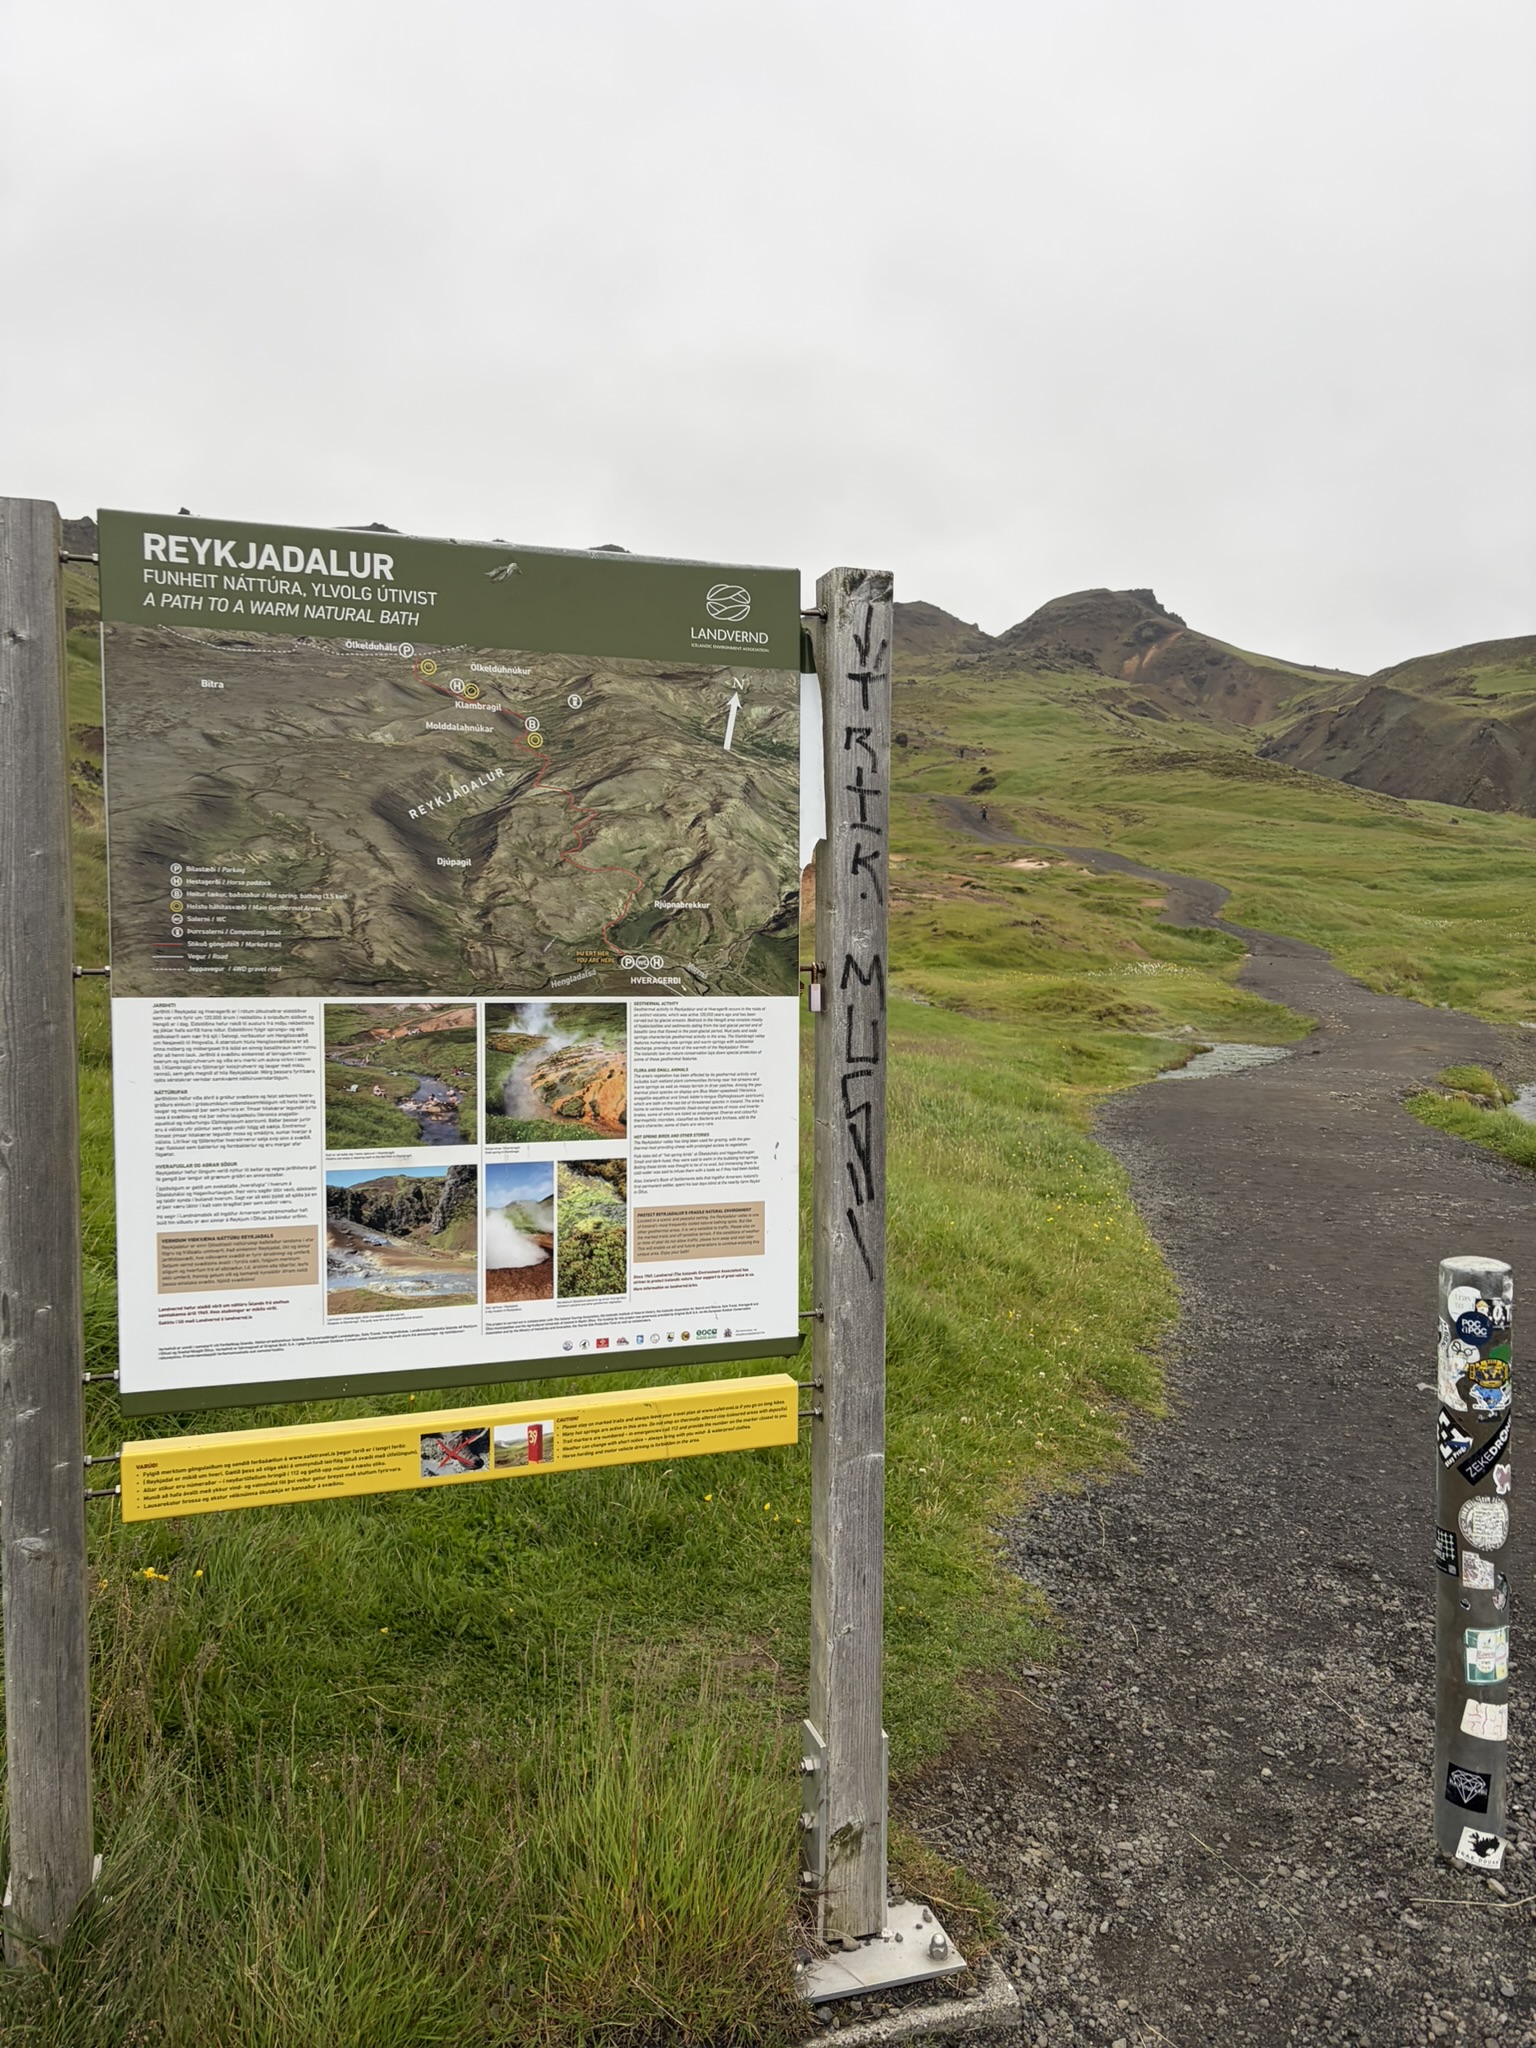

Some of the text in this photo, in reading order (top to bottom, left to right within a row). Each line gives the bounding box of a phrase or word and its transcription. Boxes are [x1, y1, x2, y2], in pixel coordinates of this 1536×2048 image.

[143, 532, 395, 581] REYKJADALUR
[144, 568, 437, 606] FUNHEIT NÁTTÚRA, YLVOLG ÚTIVIST
[144, 592, 420, 626] A PATH TO A WARM NATURAL BATH
[690, 626, 769, 644] LANDVERND
[345, 639, 398, 652] Ölkelduháls
[470, 662, 532, 676] Ölkelduhnúkur
[201, 678, 224, 690] Bitra
[732, 678, 745, 690] N
[455, 701, 502, 712] Klambragil
[408, 768, 505, 820] REYKJADALUR
[436, 858, 472, 868] Djúpagil
[654, 900, 711, 910] Rjúpnabrekkur
[1461, 1318, 1481, 1328] POC
[528, 1430, 538, 1444] 39
